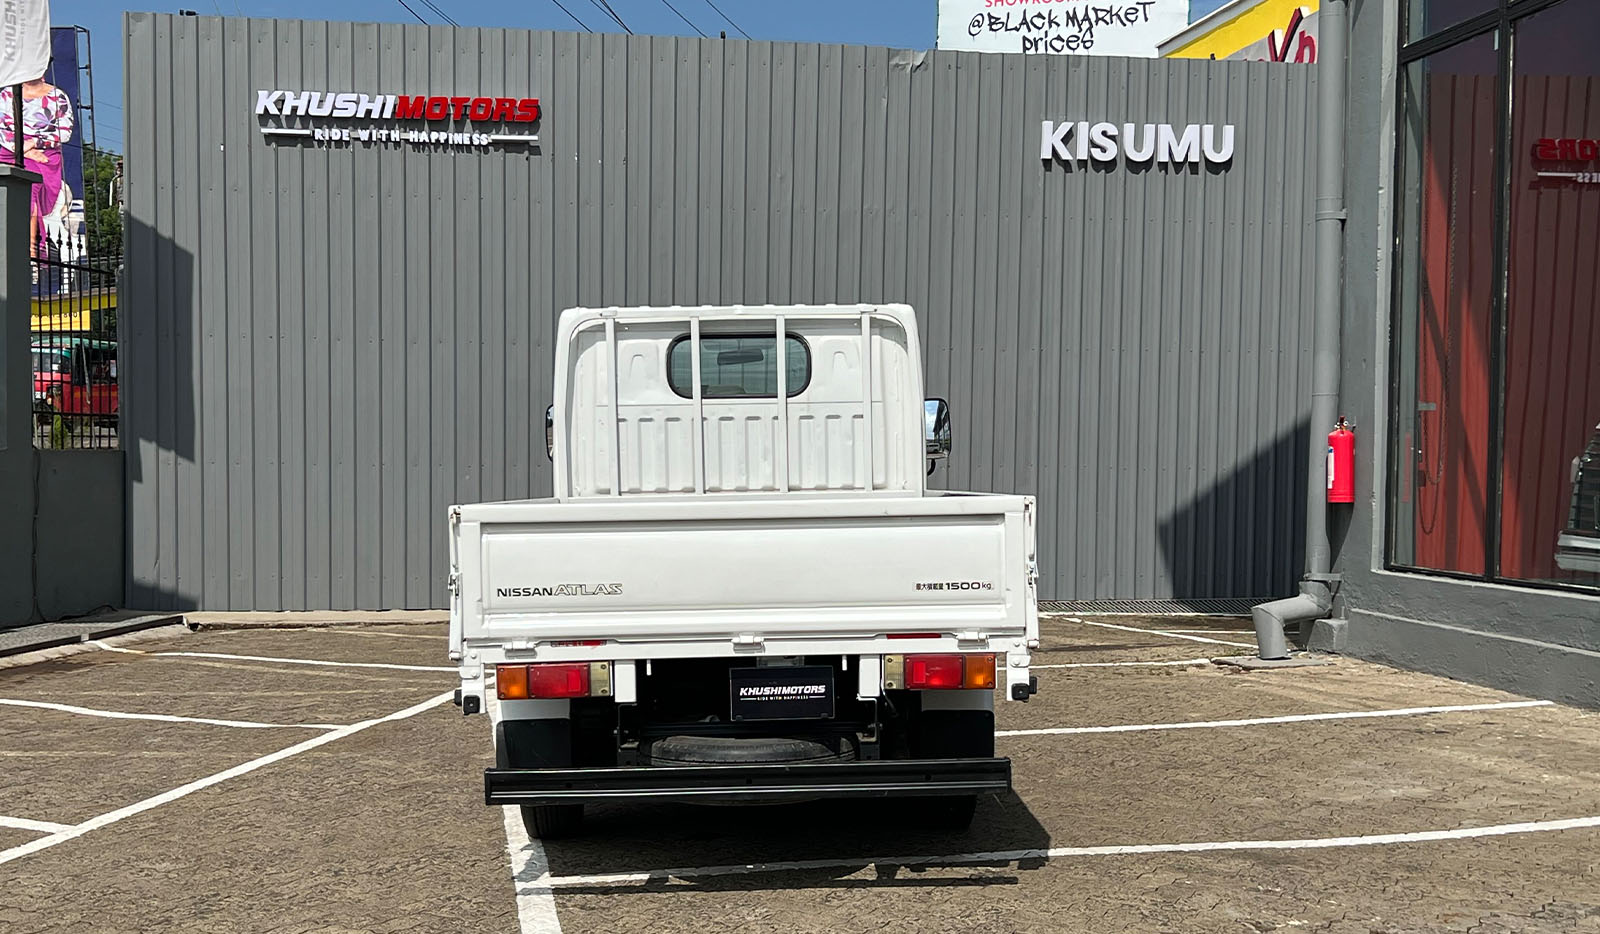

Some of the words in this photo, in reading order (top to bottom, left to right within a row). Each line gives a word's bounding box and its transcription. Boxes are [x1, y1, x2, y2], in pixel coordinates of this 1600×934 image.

[314, 128, 350, 141] RIDE
[358, 129, 400, 142] WITH
[409, 130, 489, 146] HAPPINESS
[1040, 120, 1235, 164] KISUMU
